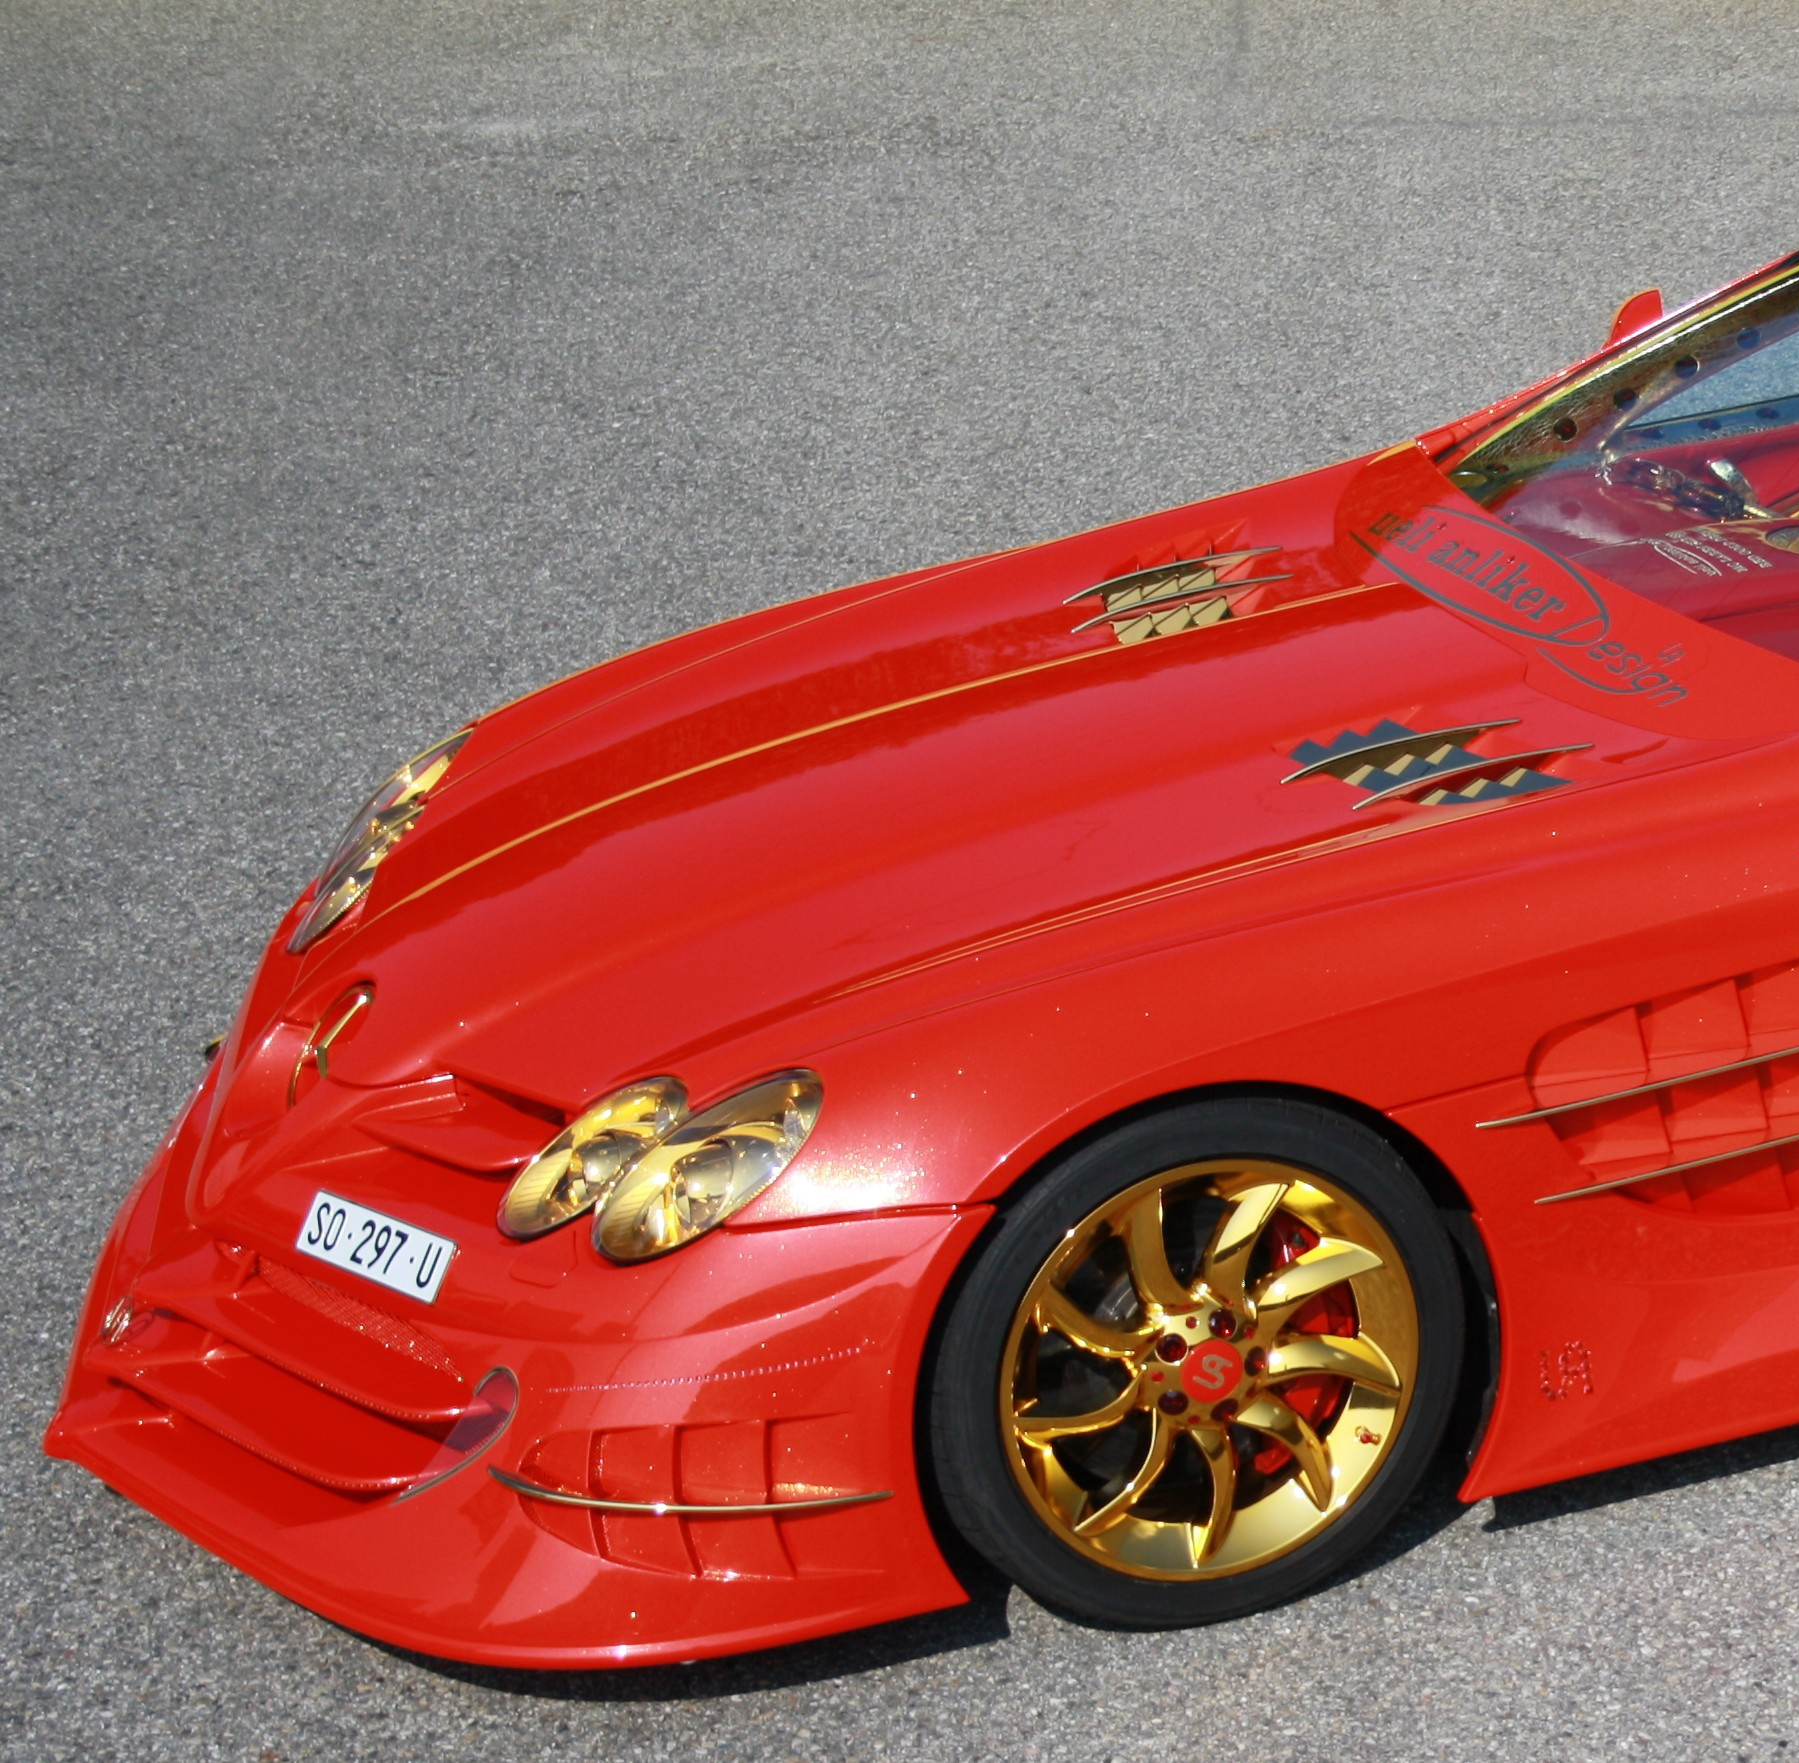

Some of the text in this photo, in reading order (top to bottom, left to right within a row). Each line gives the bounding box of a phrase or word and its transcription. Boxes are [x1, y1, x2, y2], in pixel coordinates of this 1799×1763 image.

[1368, 512, 1447, 552] ueli
[1426, 540, 1566, 622] anliker
[1537, 613, 1688, 707] Design
